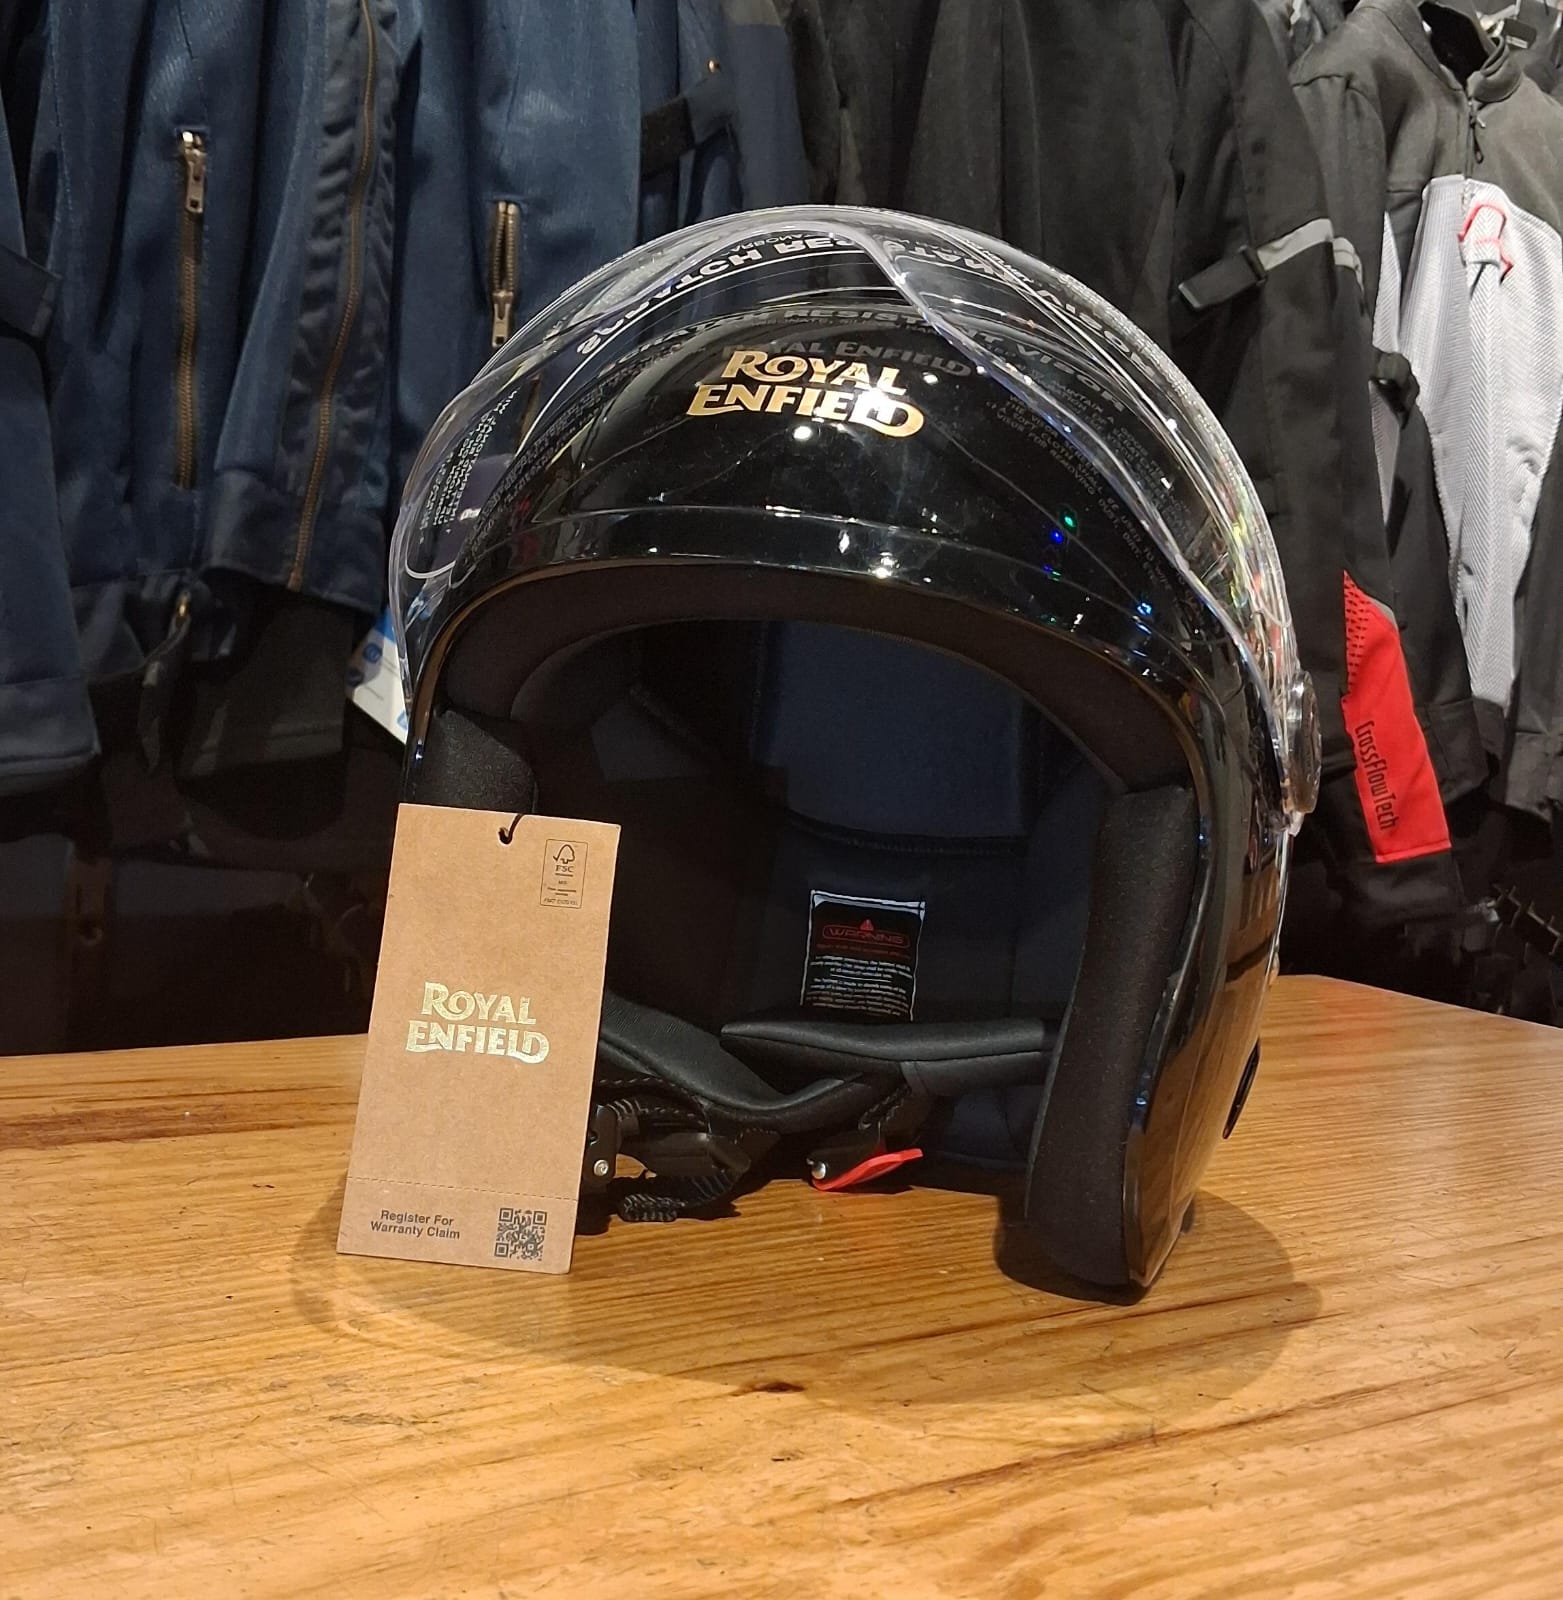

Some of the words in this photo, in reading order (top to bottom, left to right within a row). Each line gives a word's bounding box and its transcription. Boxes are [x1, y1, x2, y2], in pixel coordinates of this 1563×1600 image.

[720, 350, 906, 395] ROYAL
[836, 341, 972, 377] ENFIELD
[686, 383, 925, 437] ENFIELD
[1354, 720, 1399, 830] CrossFlowTech
[421, 981, 536, 1025] ROYAL
[405, 1020, 550, 1064] ENFIELD
[370, 1220, 424, 1239] Warranty
[426, 1225, 461, 1240] Claim
[380, 1210, 431, 1225] Register
[433, 1215, 454, 1226] For
